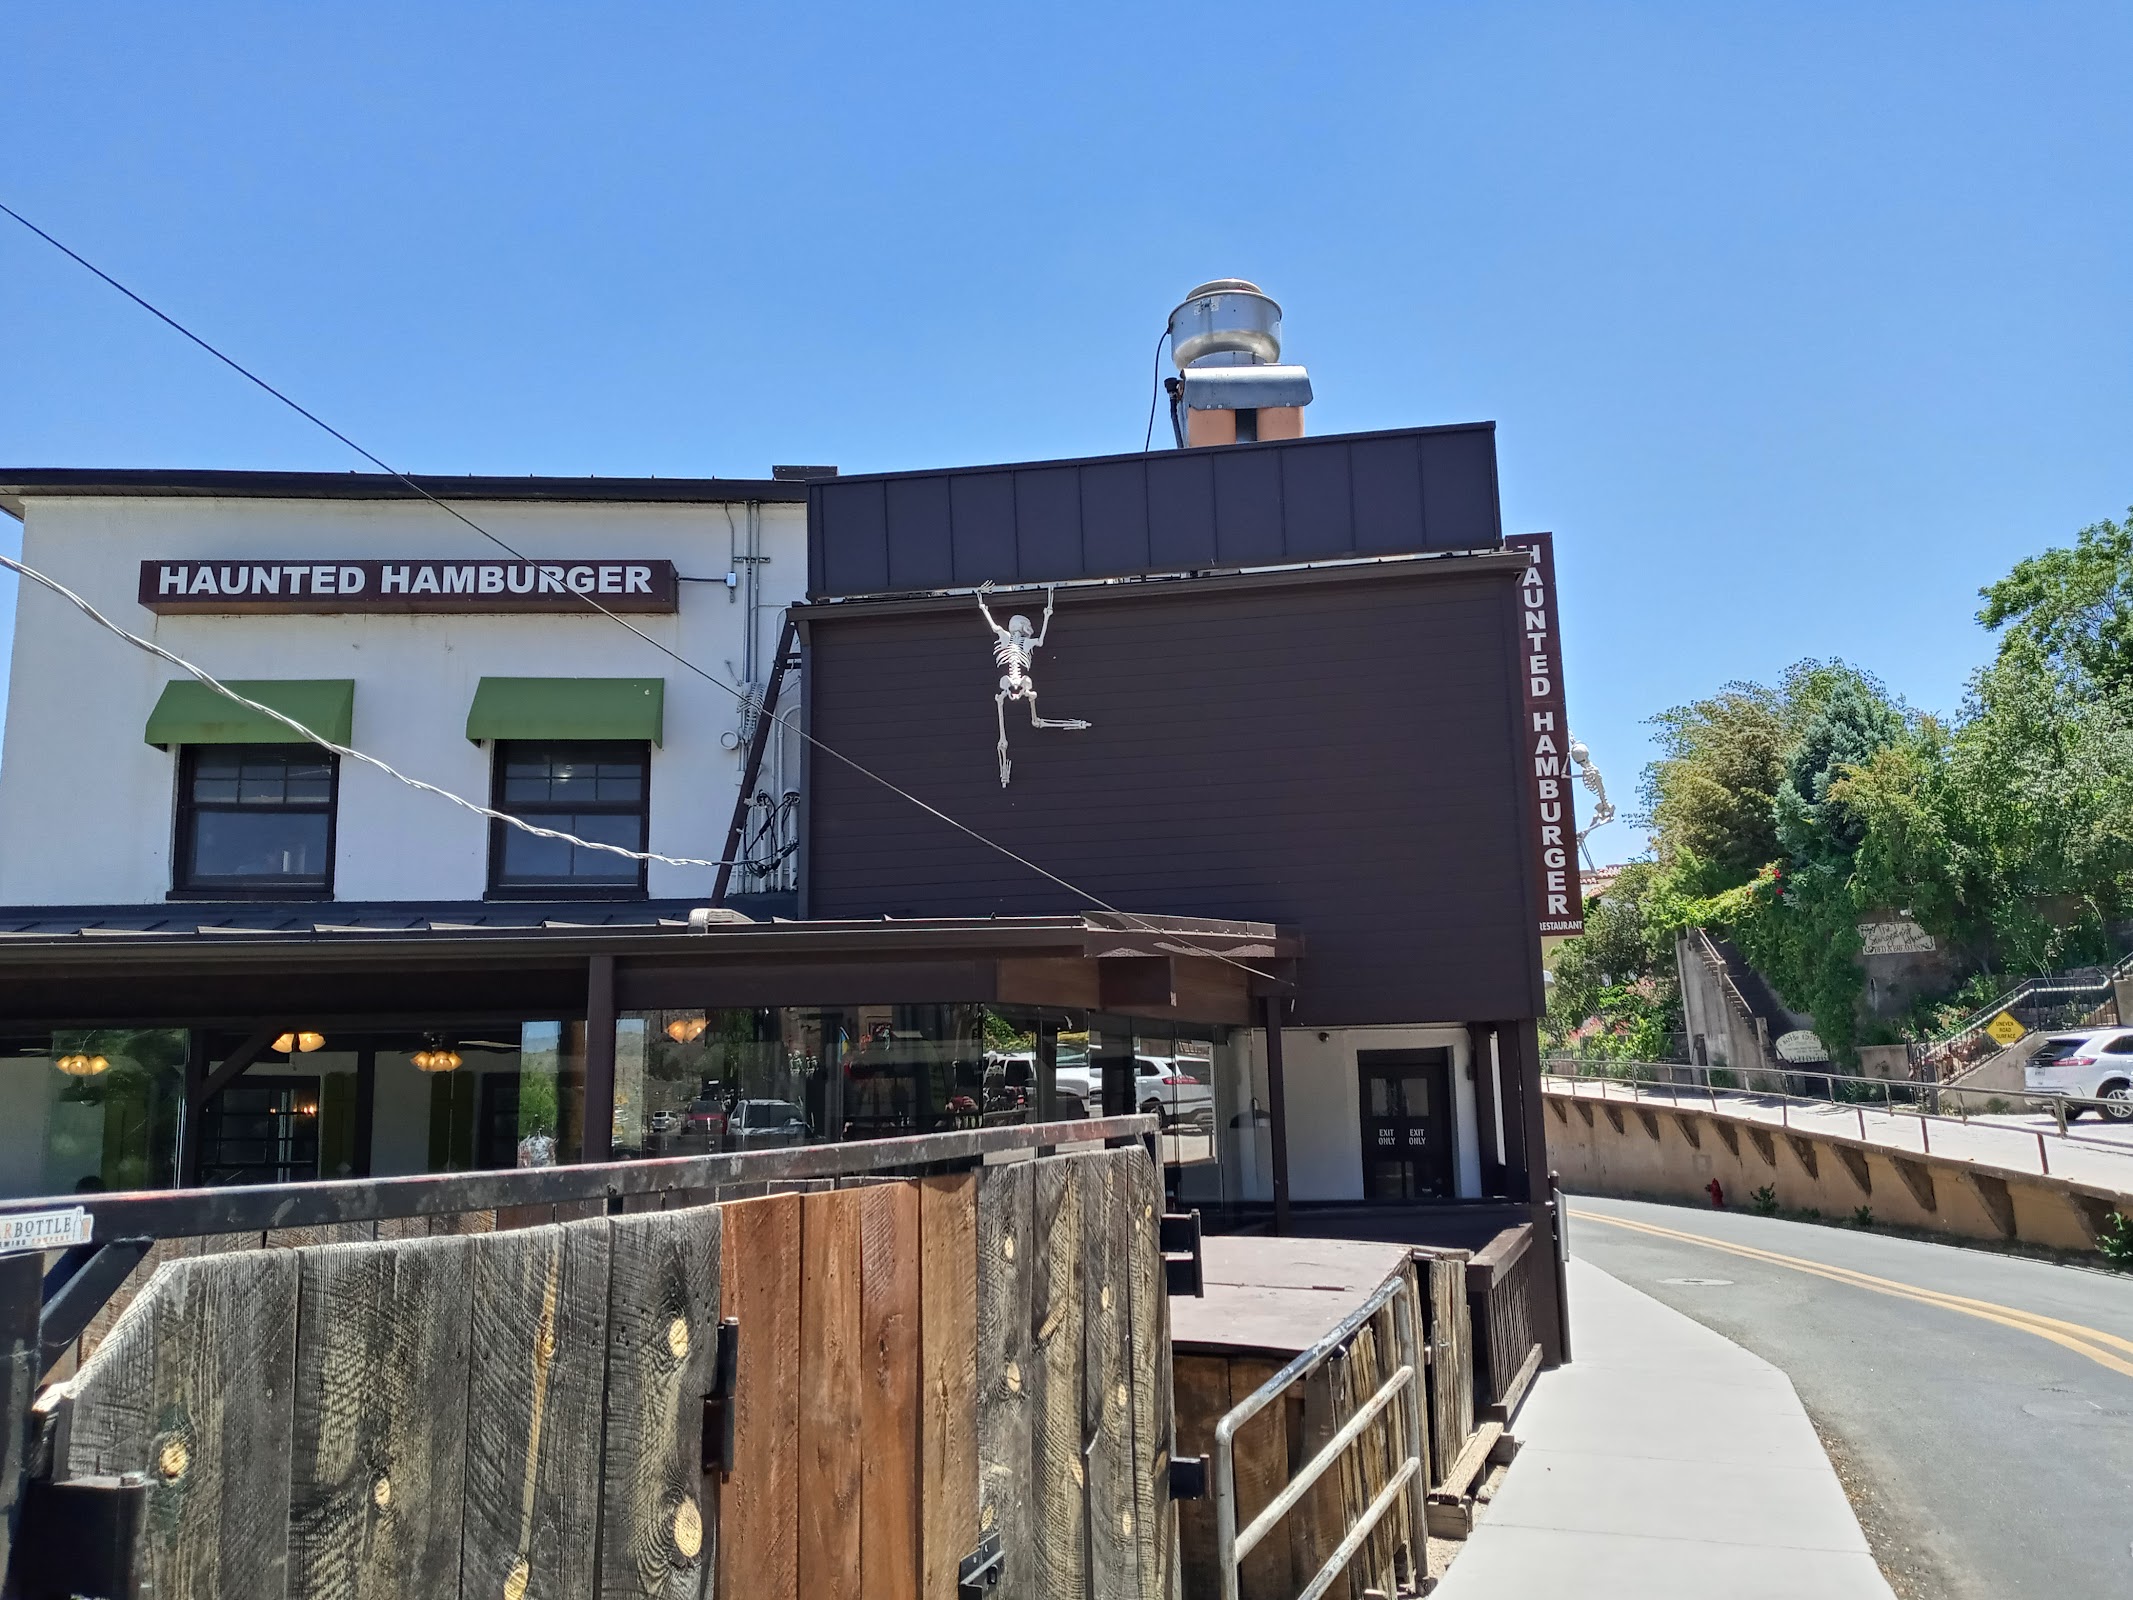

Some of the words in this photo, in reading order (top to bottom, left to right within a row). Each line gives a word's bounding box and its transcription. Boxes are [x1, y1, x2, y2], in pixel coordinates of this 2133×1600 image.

[158, 565, 366, 595] HAUNTED
[380, 565, 653, 594] HAMBURGER
[1533, 711, 1570, 915] HAMBURGER
[1379, 1128, 1394, 1137] EXIT
[1409, 1128, 1425, 1137] EXIT
[1378, 1136, 1396, 1145] ONLY
[1408, 1136, 1426, 1145] ONLY
[0, 1217, 71, 1238] RBOTTLE
